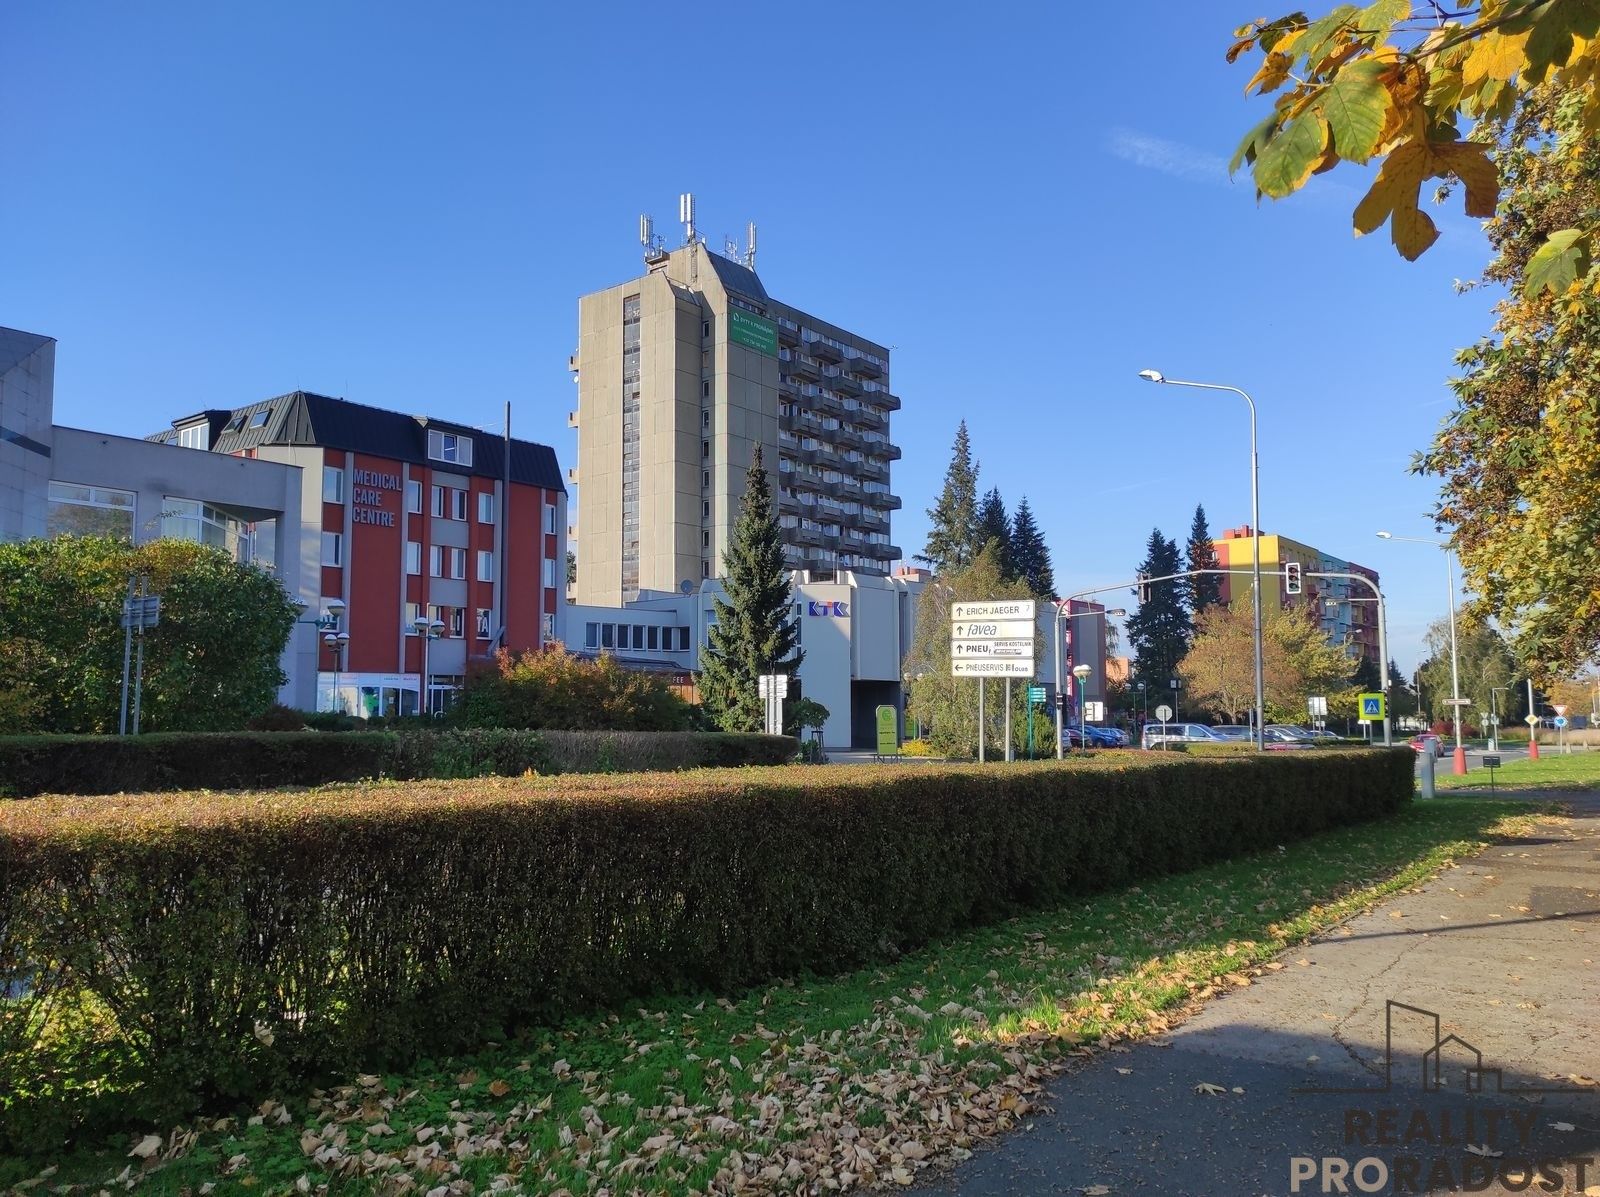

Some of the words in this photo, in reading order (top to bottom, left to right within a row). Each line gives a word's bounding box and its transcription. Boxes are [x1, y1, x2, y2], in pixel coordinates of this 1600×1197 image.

[353, 469, 402, 491] MEDICAL
[353, 487, 382, 506] CARE
[352, 506, 395, 527] CENTRE
[966, 607, 988, 615] ERICH
[990, 605, 1020, 614] JAEGER
[967, 623, 997, 637] favea
[966, 663, 1004, 672] PNEUSERVIS
